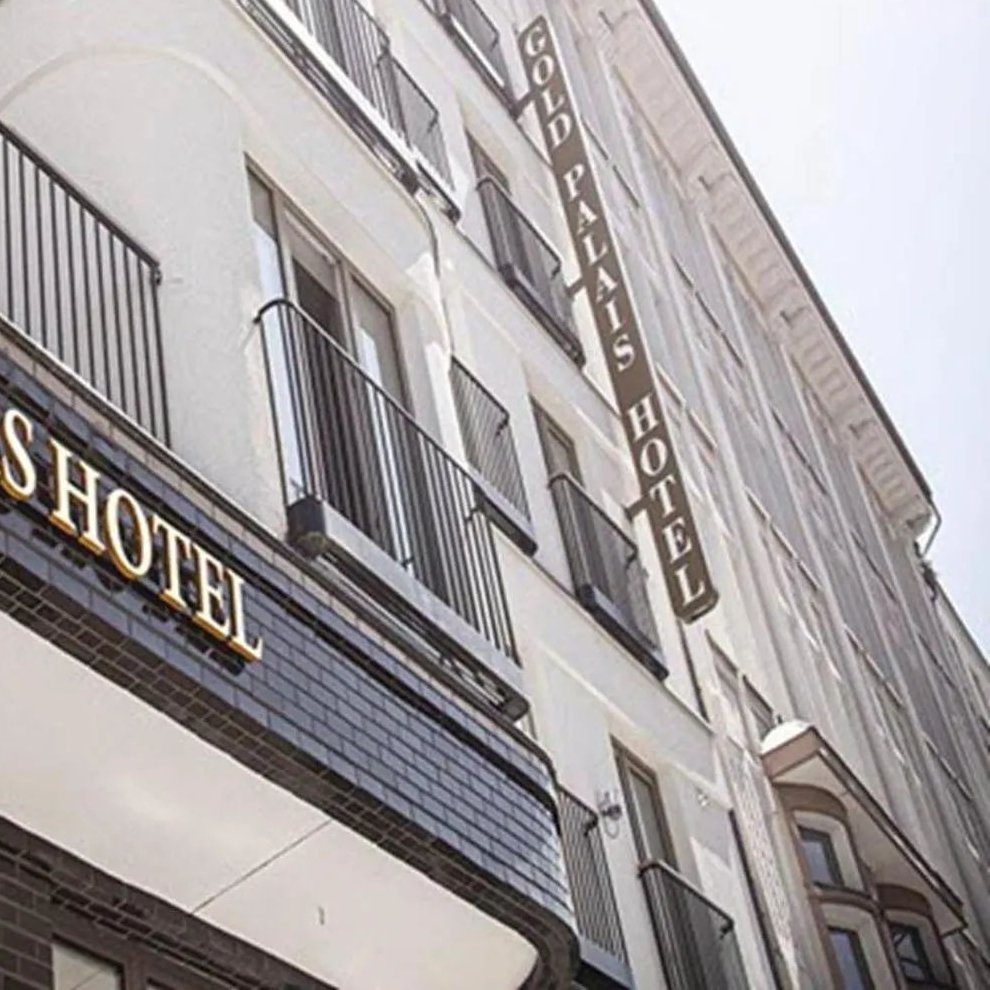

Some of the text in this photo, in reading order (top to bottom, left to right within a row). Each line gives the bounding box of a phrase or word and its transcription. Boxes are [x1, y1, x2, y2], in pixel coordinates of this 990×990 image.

[523, 25, 705, 606] GOLD PALAIS HOTEL
[49, 439, 263, 663] HOTEL
